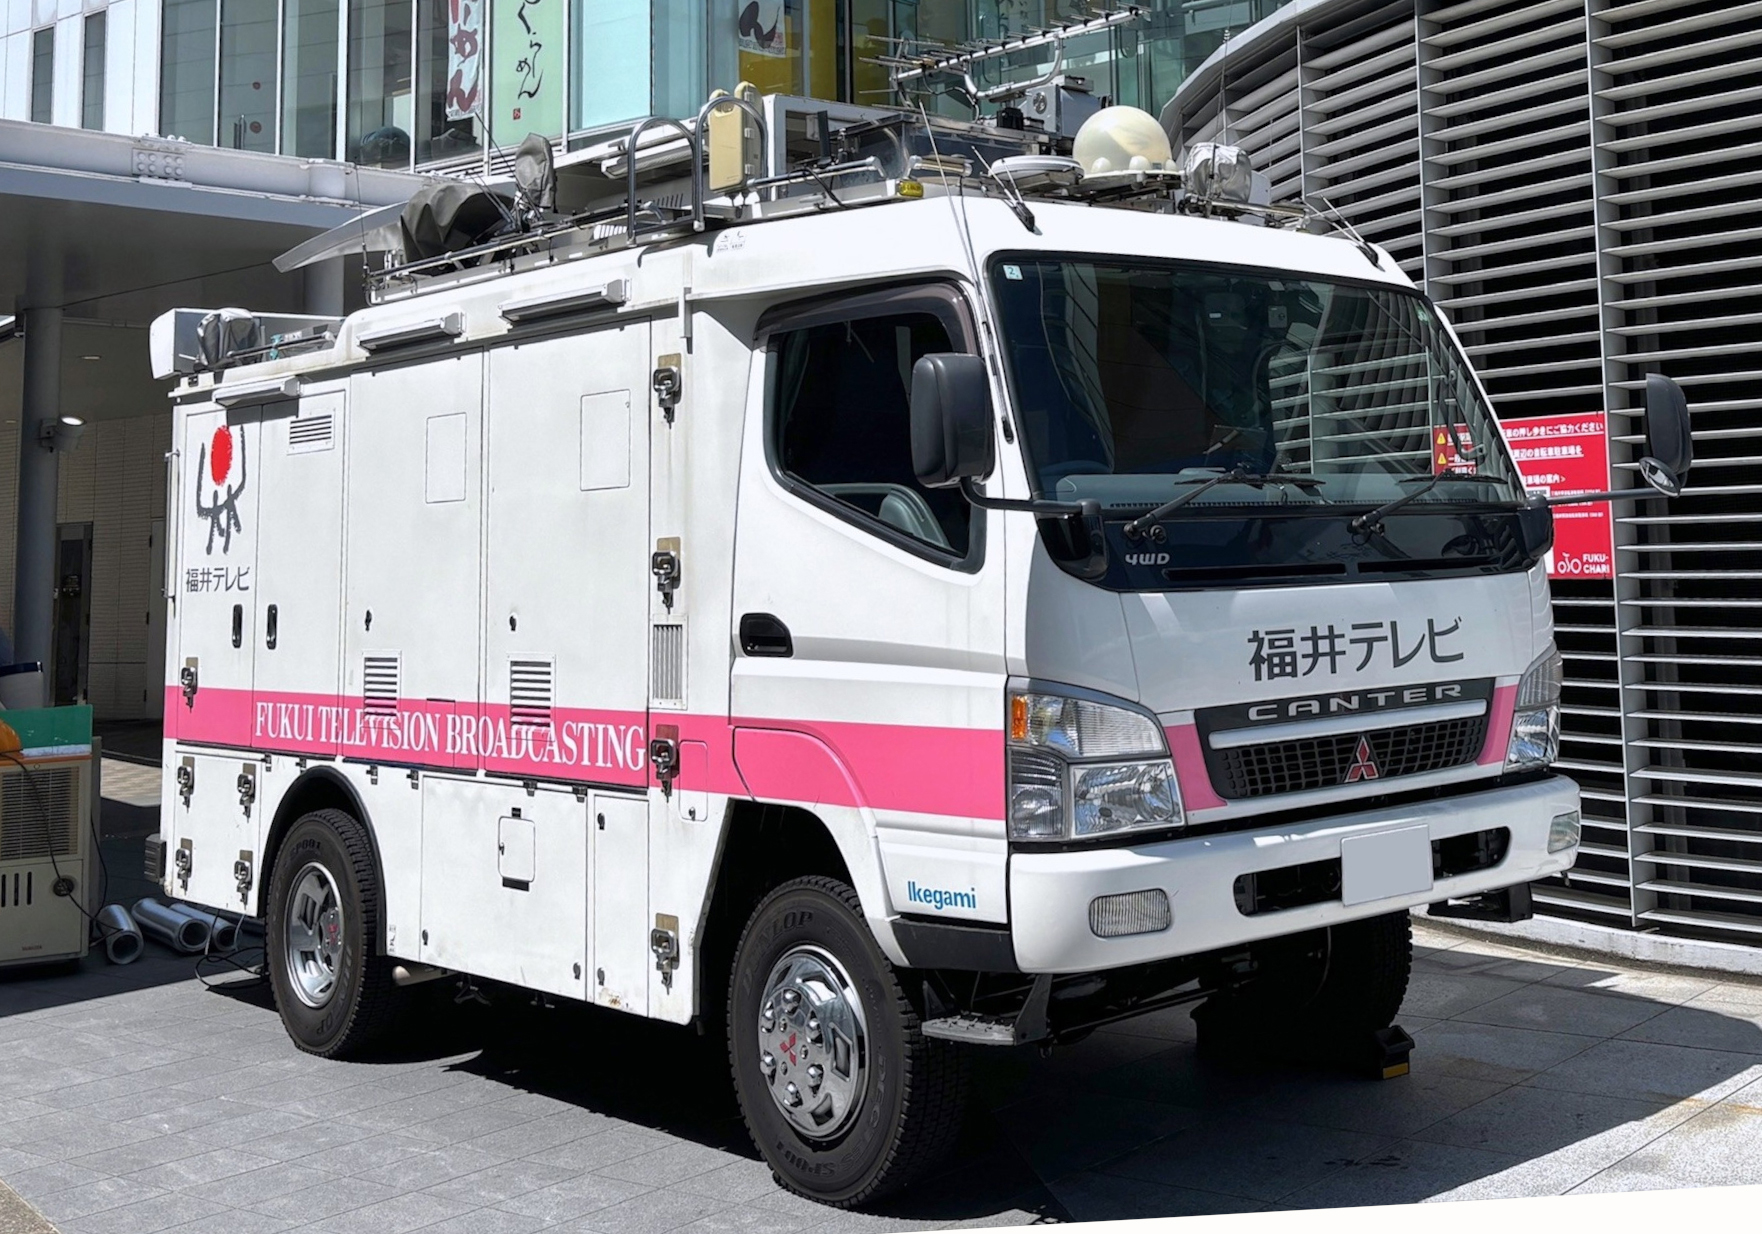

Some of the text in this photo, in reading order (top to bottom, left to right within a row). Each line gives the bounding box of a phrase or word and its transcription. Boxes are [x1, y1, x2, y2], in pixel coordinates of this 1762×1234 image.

[1125, 553, 1170, 566] 4WD
[1582, 553, 1609, 562] FUKU-
[1583, 563, 1610, 574] CHARI
[186, 566, 250, 593] 福井テレビ
[1247, 616, 1464, 682] 福井テレビ
[1248, 684, 1462, 721] CANTER
[255, 702, 646, 771] FUKUI TELEVISION BROADCASTING
[907, 880, 977, 910] Ikegami
